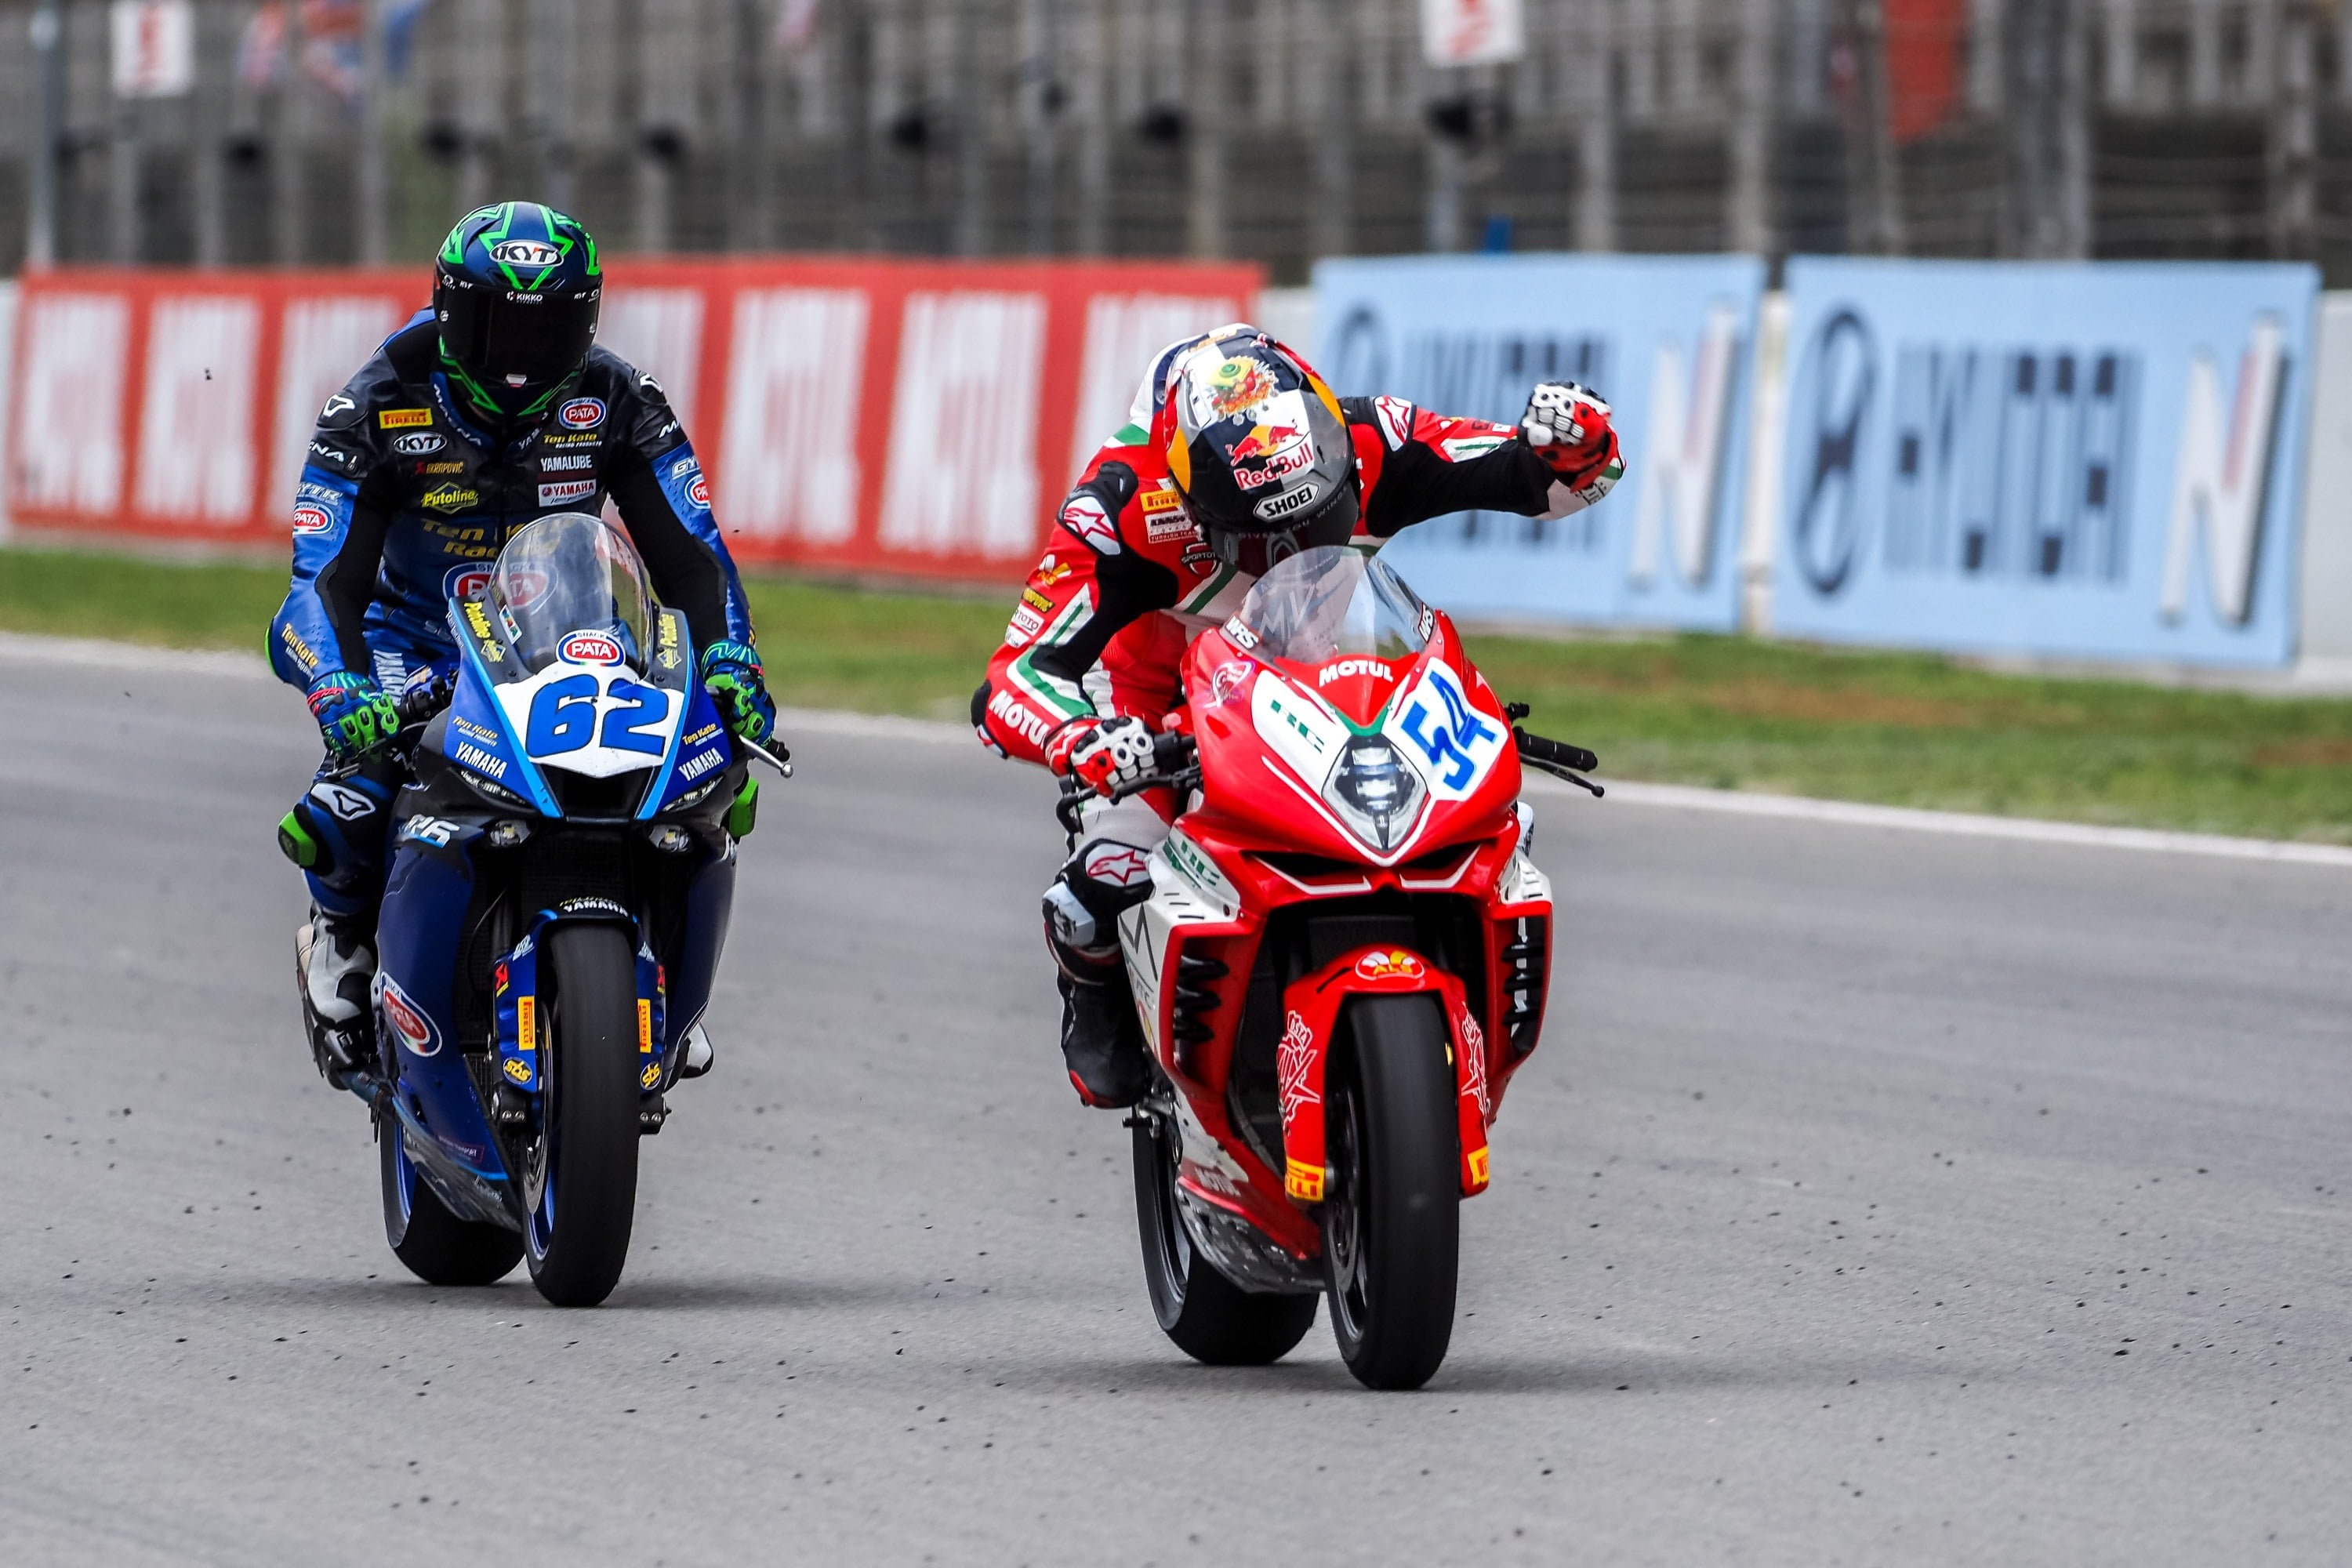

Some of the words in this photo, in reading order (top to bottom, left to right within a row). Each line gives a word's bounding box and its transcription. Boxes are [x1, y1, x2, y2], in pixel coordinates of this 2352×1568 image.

[498, 245, 556, 264] KYT
[568, 407, 595, 420] PATA
[401, 436, 442, 451] KYT
[541, 455, 592, 472] YAMALUBE
[1233, 458, 1279, 491] Red
[1276, 442, 1315, 477] Bull
[423, 489, 477, 507] Putoline
[554, 482, 594, 495] YAMAHA
[1263, 486, 1312, 517] SHOEI
[572, 642, 612, 659] PATA
[1318, 659, 1394, 688] MOTUL
[452, 715, 472, 729] Ten
[526, 673, 670, 758] 62
[682, 733, 699, 746] Ten
[697, 723, 717, 738] Kate
[1402, 669, 1498, 793] 54
[455, 741, 508, 779] YAMAHA
[678, 747, 724, 782] YAMAHA
[563, 900, 629, 917] YAMAHA
[523, 1000, 534, 1044] PIRELLI
[637, 1004, 648, 1048] PIRELLI
[505, 1058, 531, 1082] sbs
[642, 1062, 661, 1089] sbs
